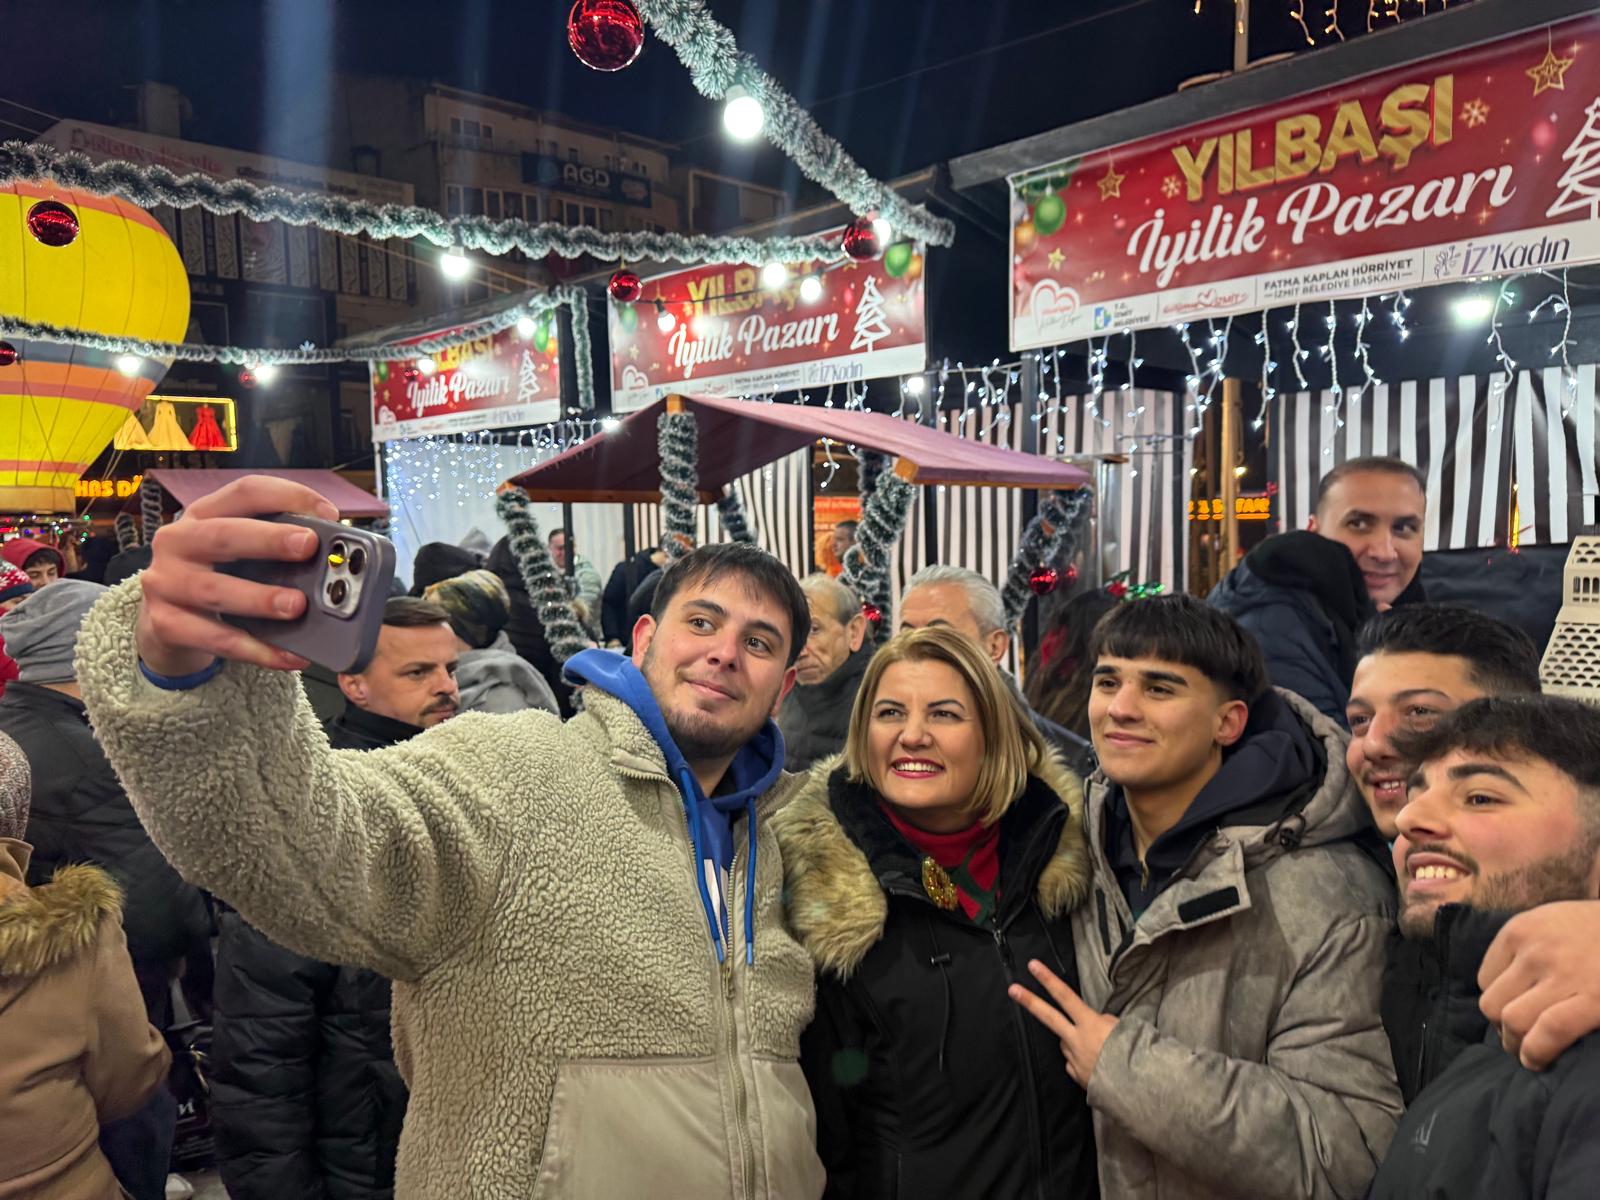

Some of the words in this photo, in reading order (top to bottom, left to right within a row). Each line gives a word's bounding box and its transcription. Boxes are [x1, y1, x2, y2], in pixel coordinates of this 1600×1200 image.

[1171, 74, 1454, 202] YILBAŞI
[563, 162, 611, 189] AGD
[1126, 196, 1267, 289] İyilik
[1275, 163, 1517, 245] Pazarı
[1263, 276, 1300, 291] FATMA
[1303, 266, 1349, 284] KAPLAN
[1351, 258, 1413, 275] HÜRRİYET
[1302, 279, 1351, 294] BELEDİYE
[1353, 271, 1401, 287] BAŞKANI
[737, 312, 841, 356] Pazarı
